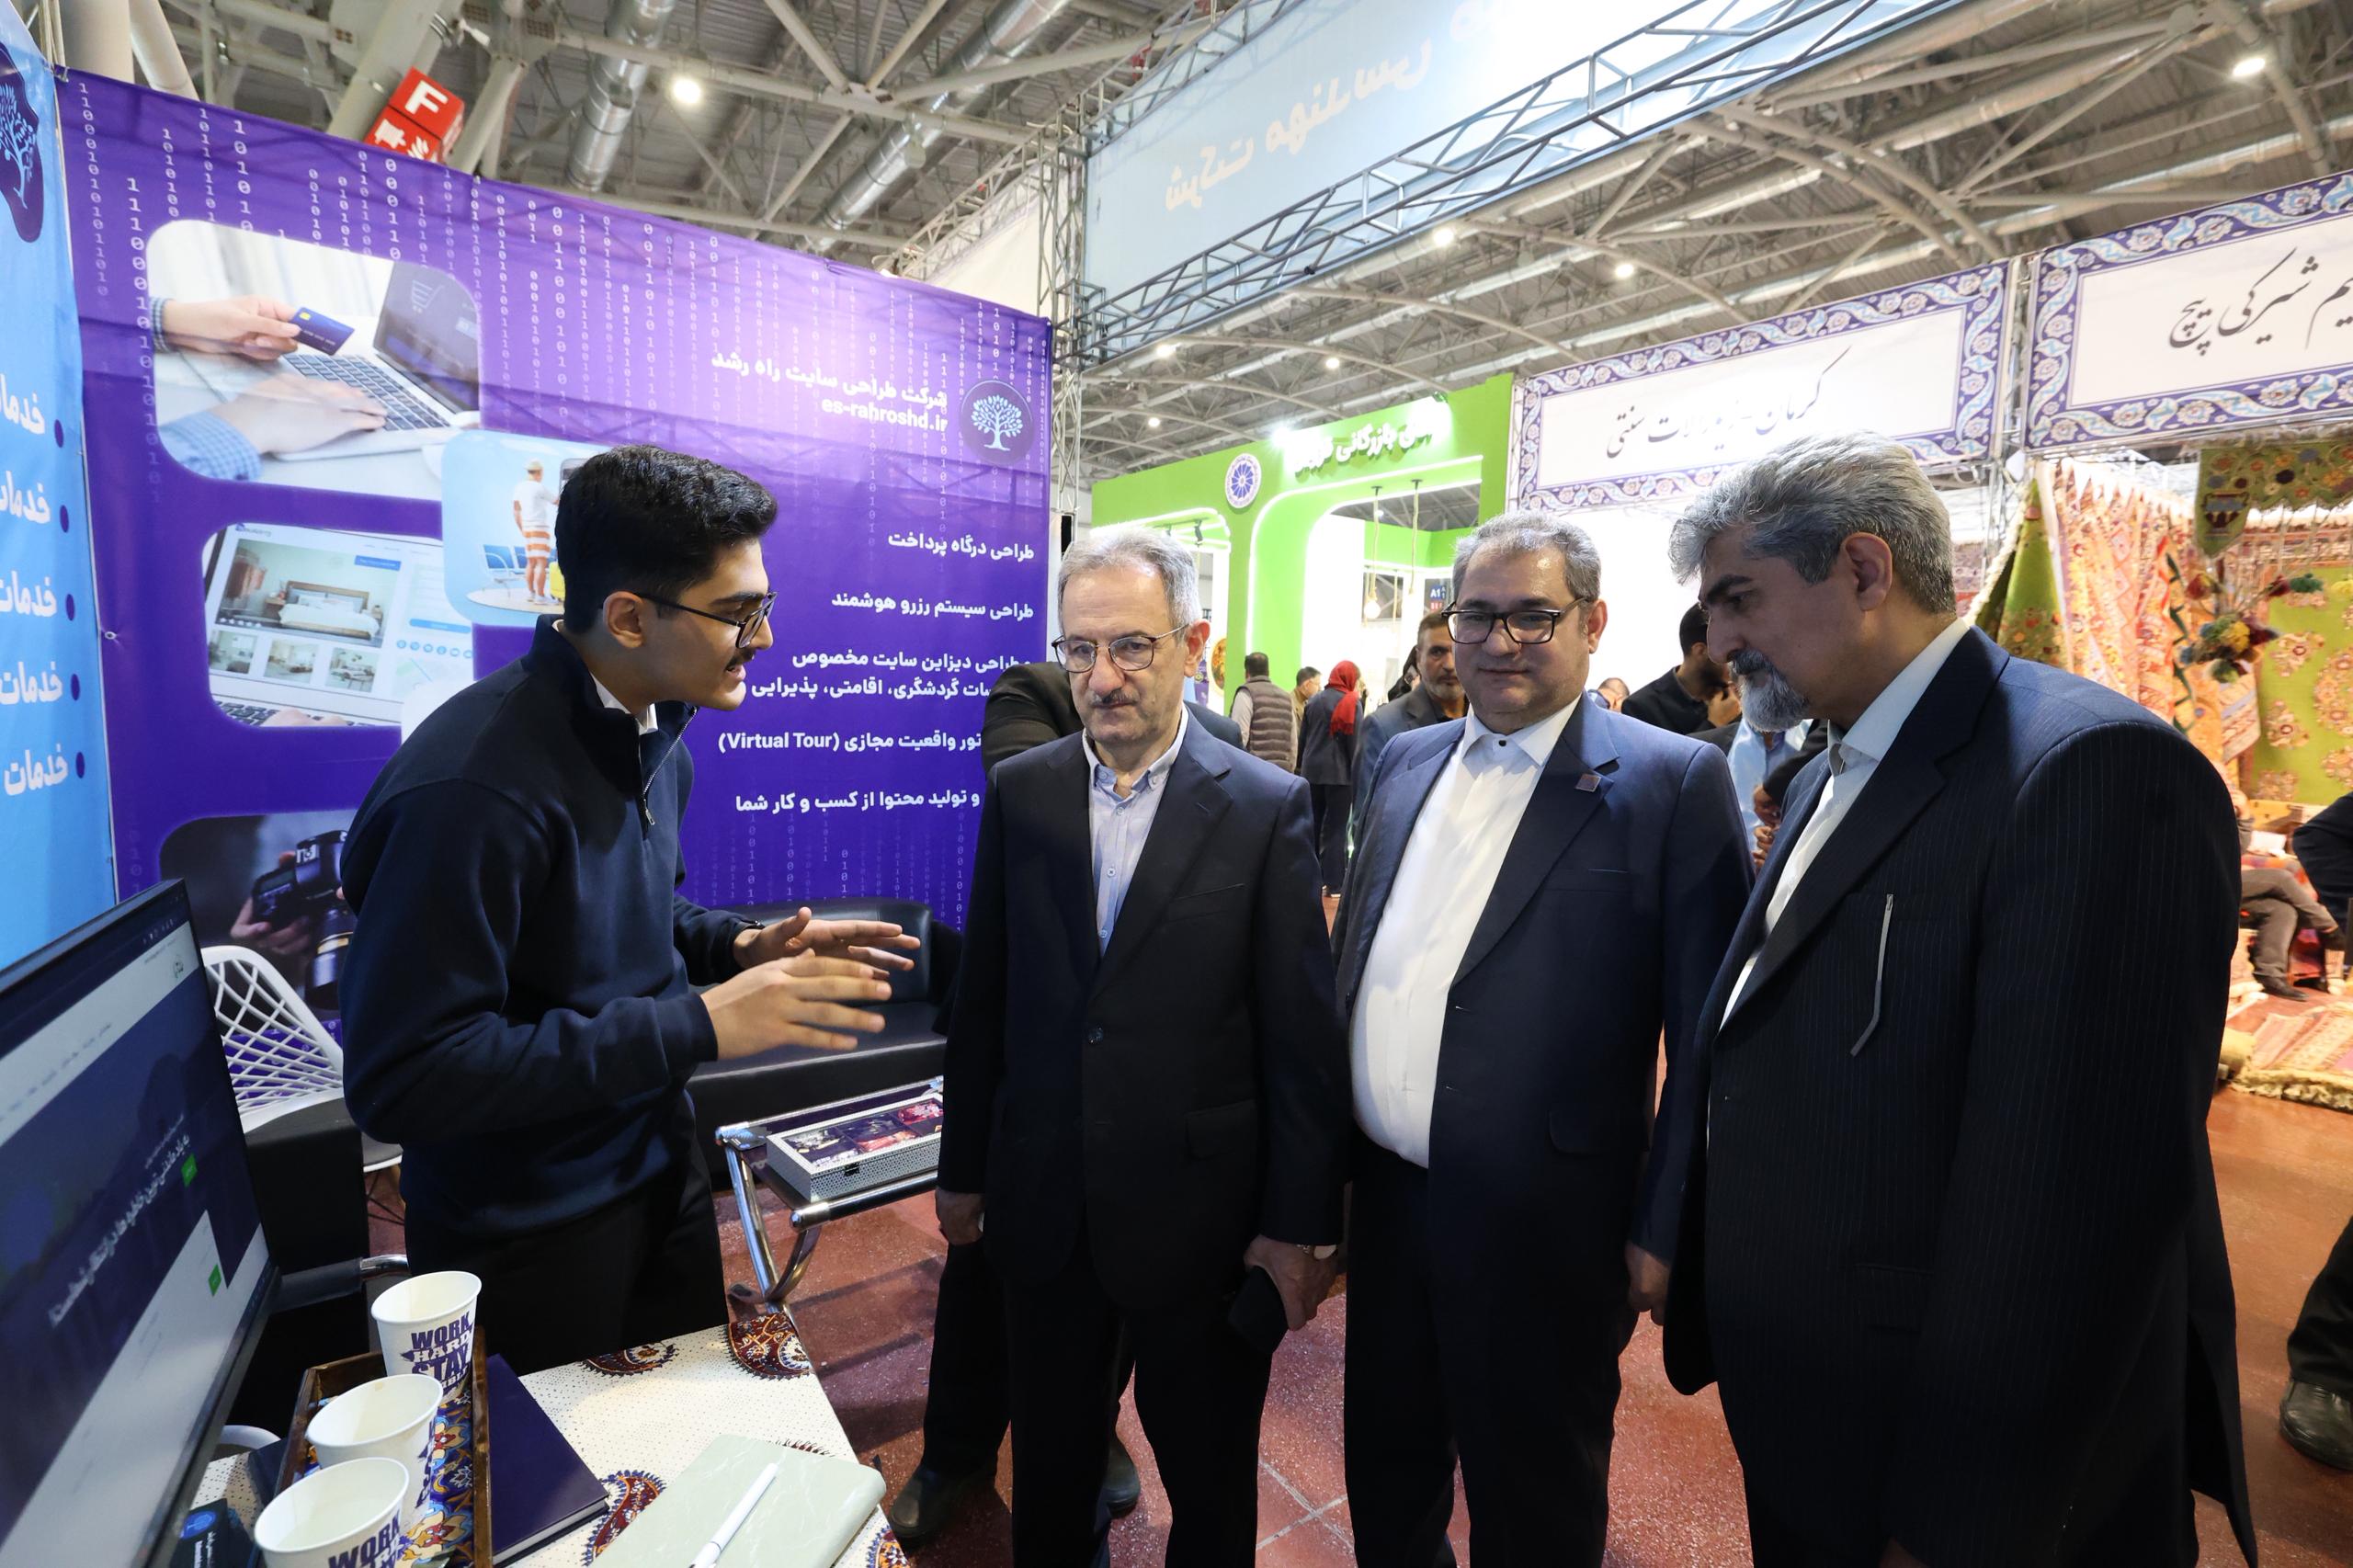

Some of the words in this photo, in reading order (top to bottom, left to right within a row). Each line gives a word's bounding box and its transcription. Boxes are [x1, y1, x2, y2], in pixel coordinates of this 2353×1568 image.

[404, 79, 449, 115] F
[711, 351, 749, 376] رشد
[755, 358, 780, 381] راه
[786, 367, 837, 388] سایت
[843, 378, 896, 400] طراحی
[902, 387, 948, 409] شرکت
[821, 399, 948, 432] es-rahroshd.ir
[888, 532, 948, 557] پرداخت
[951, 534, 986, 558] درگاه
[990, 543, 1035, 562] طراحی
[831, 592, 896, 613] هوشمند
[900, 598, 930, 616] رزرو
[934, 600, 986, 618] سیستم
[989, 602, 1034, 621] طراحی
[791, 648, 869, 668] مخصوص
[872, 651, 917, 668] سایت
[921, 653, 972, 672] دیزاین
[0, 661, 63, 705] خدمات
[751, 676, 818, 699] پذیرایی
[718, 733, 789, 754] (Virtual
[793, 733, 840, 751] Tour)
[844, 732, 893, 752] مجازی
[898, 730, 956, 751] واقعیت
[4, 743, 69, 796] خدمات
[735, 794, 768, 812] شما
[772, 793, 795, 814] کار
[800, 797, 810, 813] و
[814, 791, 858, 812] کسب
[861, 791, 874, 811] از
[880, 791, 925, 811] محتوا
[928, 790, 968, 809] تولید
[411, 1311, 471, 1351] WORK
[413, 1330, 471, 1363] HARD
[412, 1343, 469, 1381] STAY
